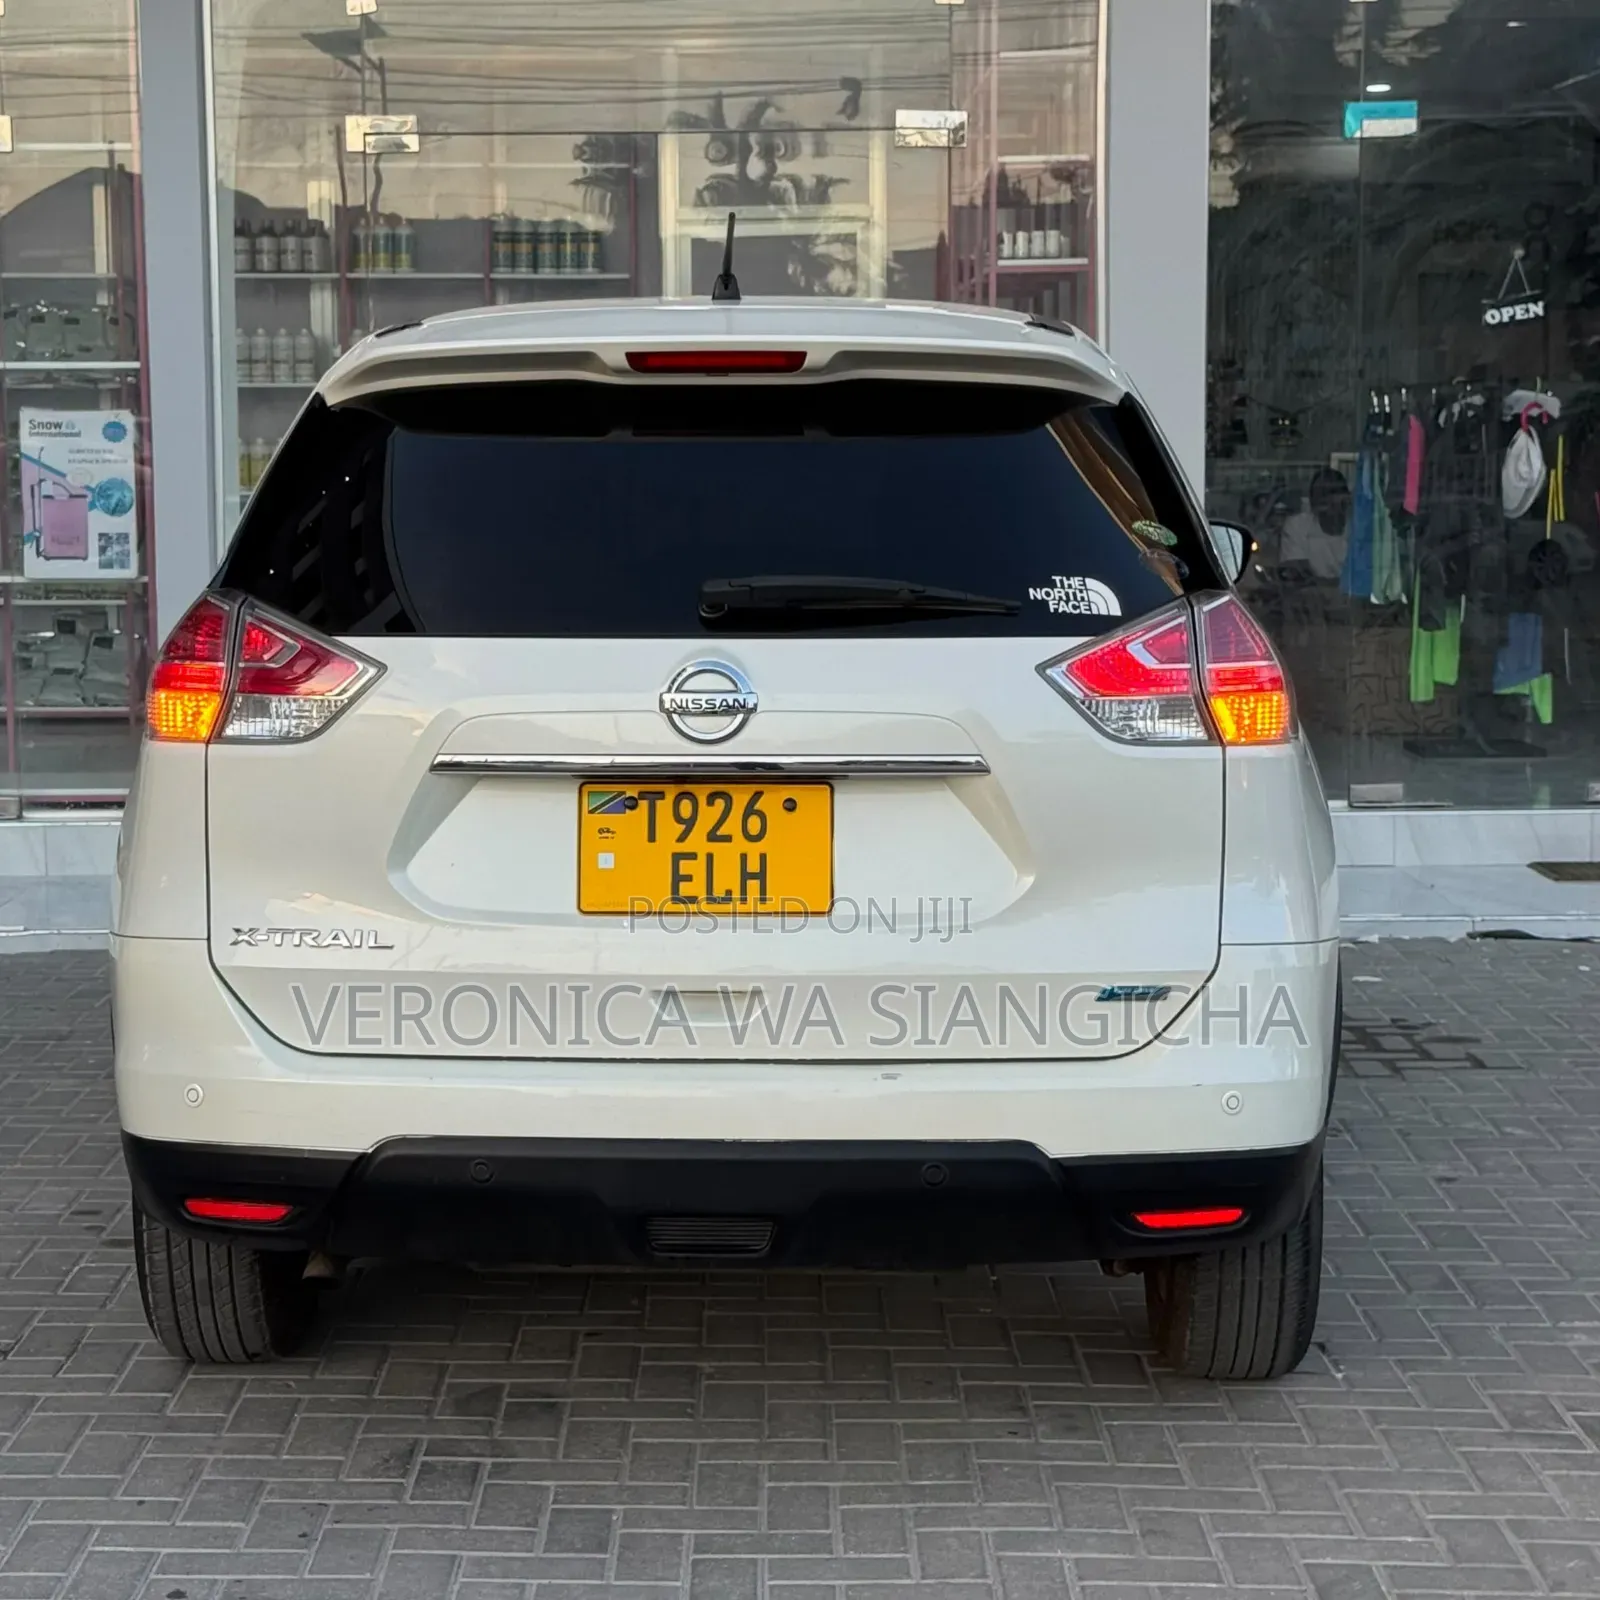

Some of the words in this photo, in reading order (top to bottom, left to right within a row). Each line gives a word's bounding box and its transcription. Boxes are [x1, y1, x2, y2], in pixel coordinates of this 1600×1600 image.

[1485, 301, 1544, 325] OPEN
[28, 419, 63, 430] Snow
[1051, 575, 1086, 590] THE
[1028, 587, 1089, 602] NORTH
[1048, 601, 1092, 615] FACE
[669, 697, 747, 711] NISSAN
[638, 790, 768, 843] T926
[670, 852, 768, 905] ELH
[229, 927, 395, 950] X-TRAIL
